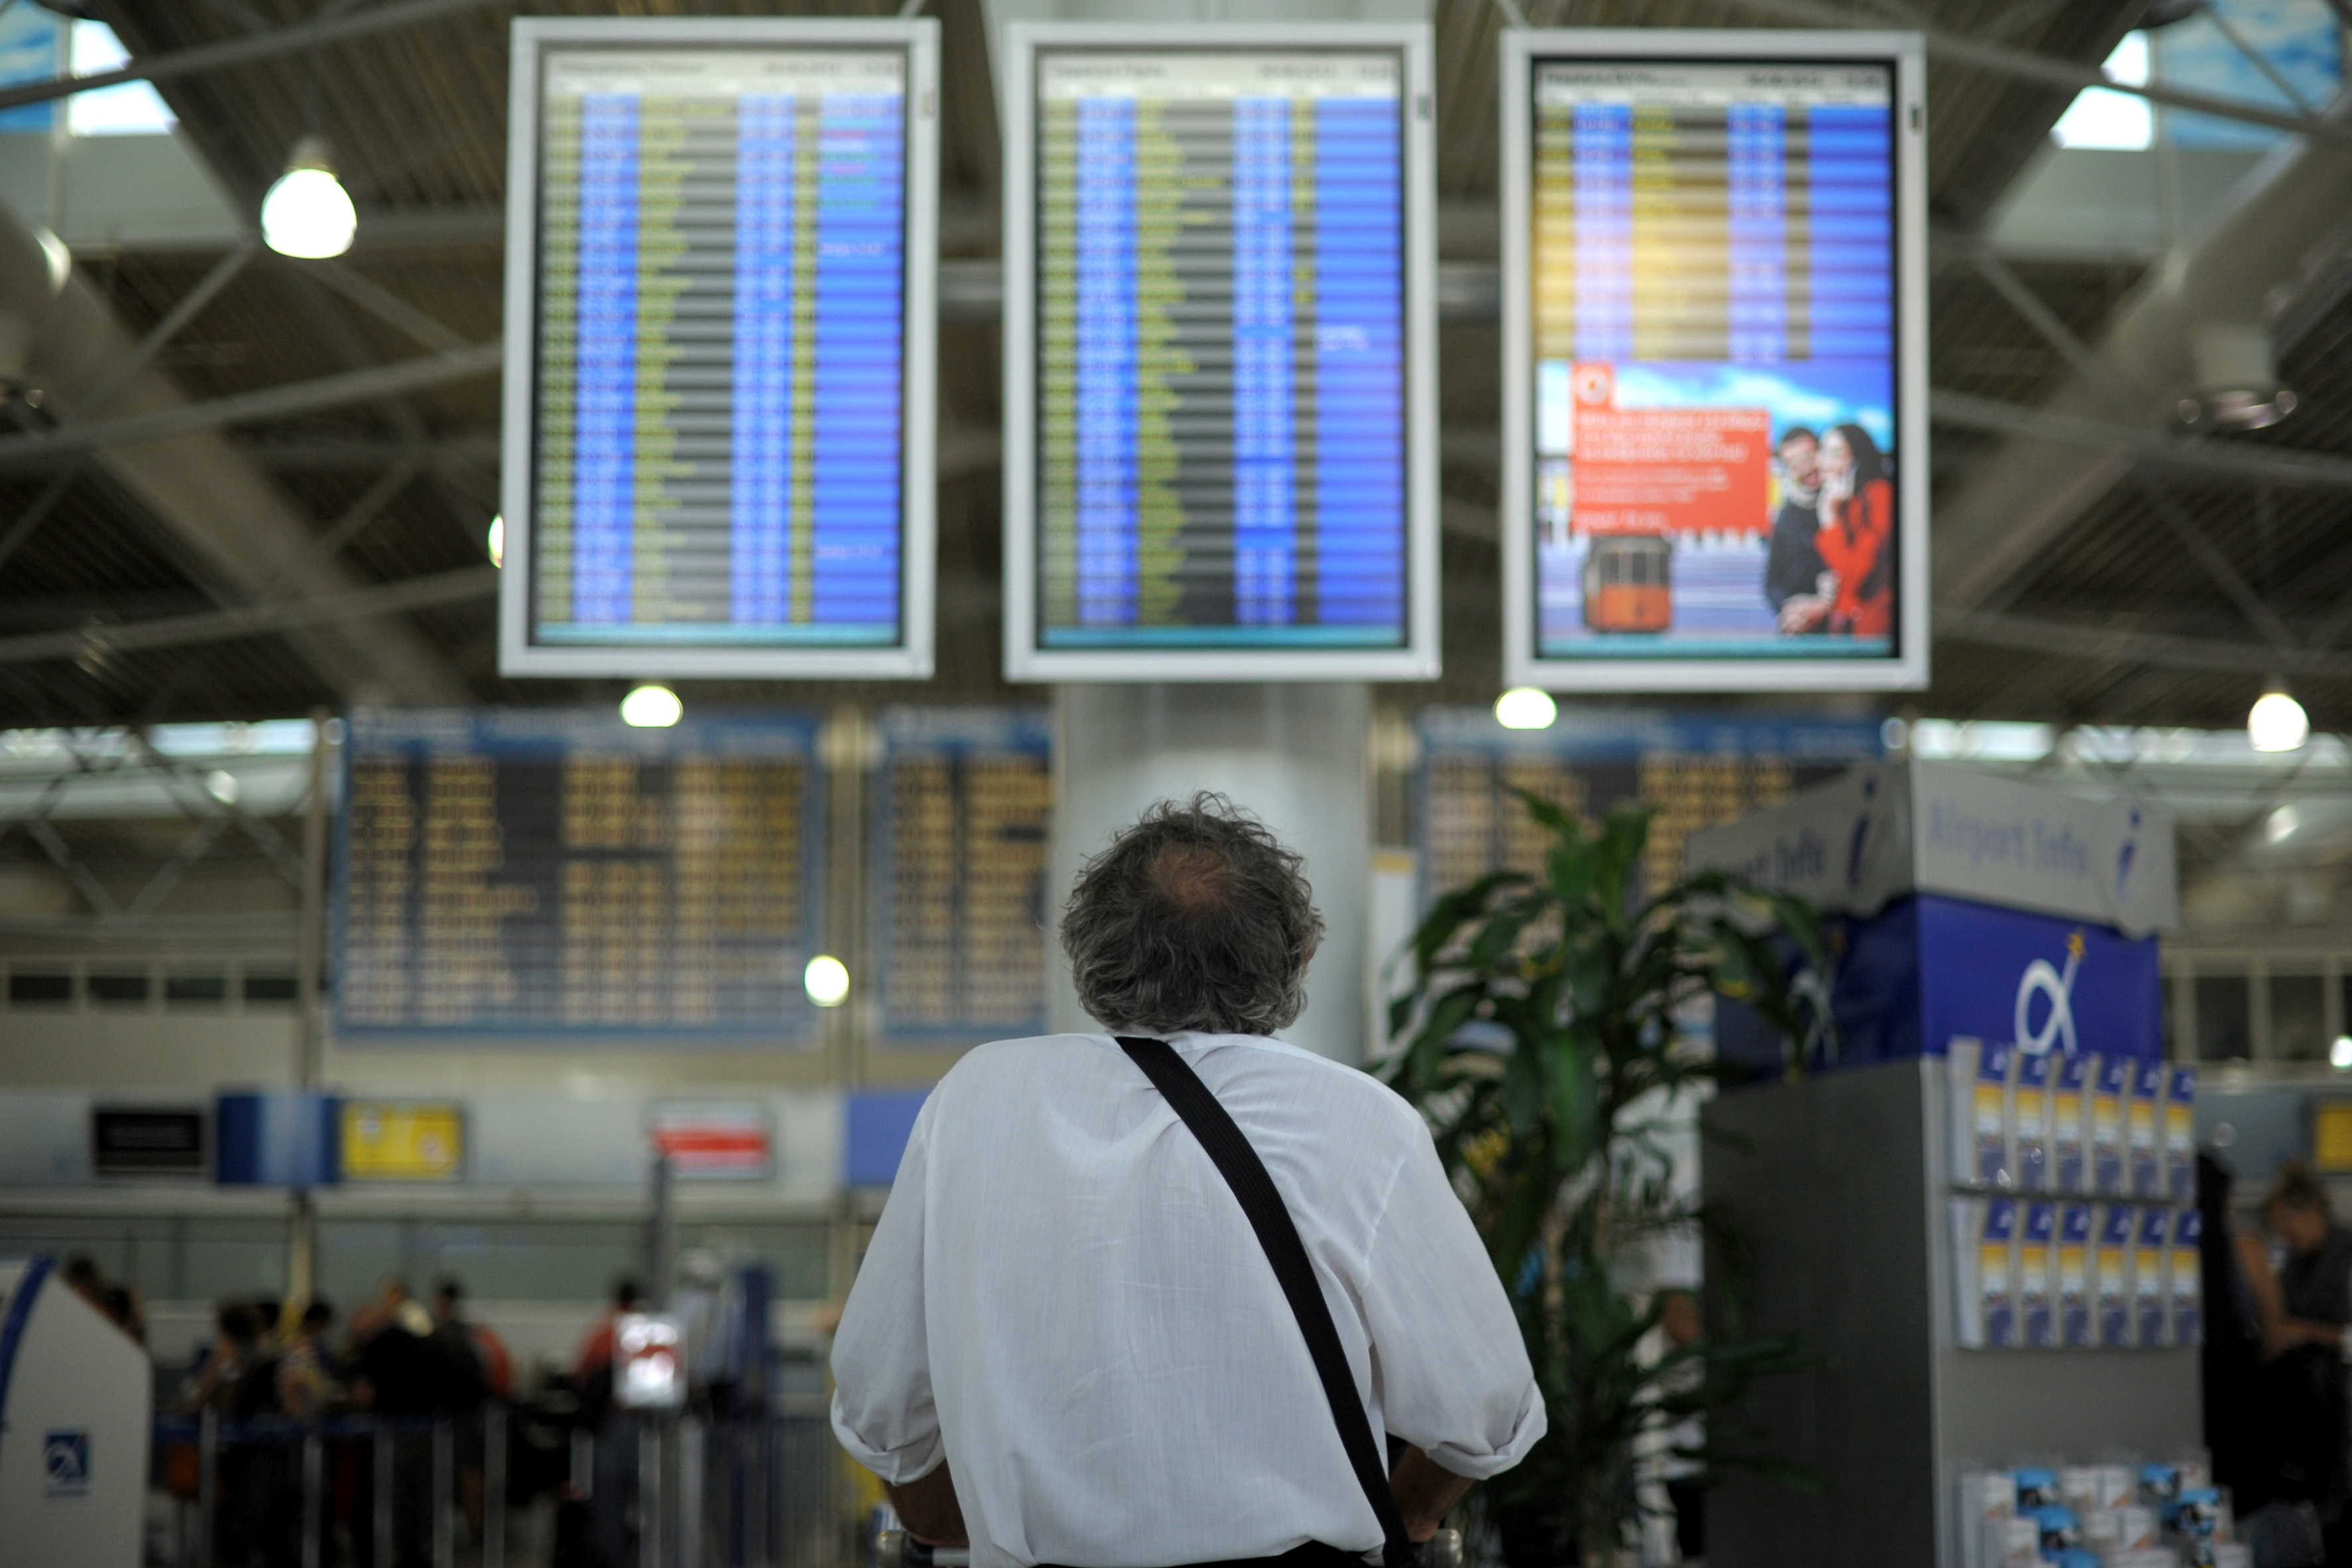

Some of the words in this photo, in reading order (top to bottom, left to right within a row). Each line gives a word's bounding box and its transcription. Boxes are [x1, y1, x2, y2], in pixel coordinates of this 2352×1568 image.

[1774, 826, 1826, 884] Info
[1929, 797, 2028, 870] Airport
[2033, 817, 2087, 879] Info
